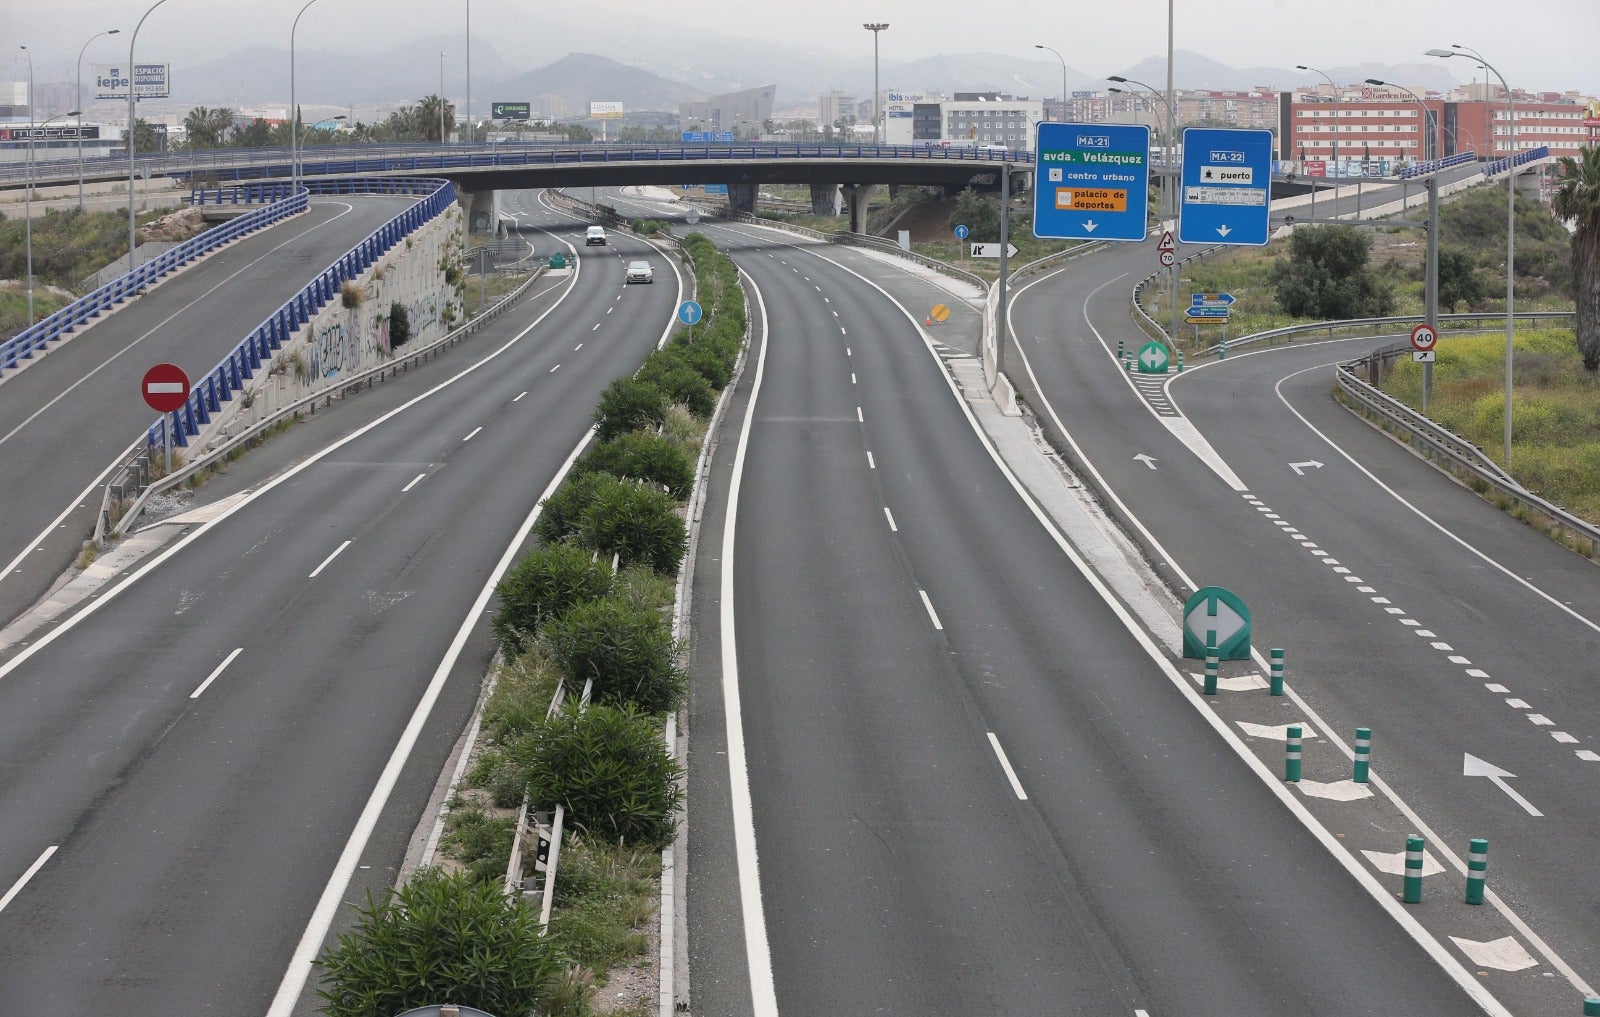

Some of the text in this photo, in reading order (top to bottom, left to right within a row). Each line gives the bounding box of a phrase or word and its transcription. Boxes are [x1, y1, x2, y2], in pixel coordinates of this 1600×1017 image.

[97, 76, 129, 90] iepe
[888, 93, 903, 101] ibis
[1078, 137, 1108, 146] MA-21
[1043, 152, 1142, 165] avda. Velázquez
[1211, 153, 1243, 161] MA-22
[1067, 172, 1135, 182] centro urbano
[1220, 172, 1250, 180] puerto
[1074, 190, 1125, 199] palacio de
[1074, 201, 1115, 210] deportes
[1416, 333, 1432, 343] 40
